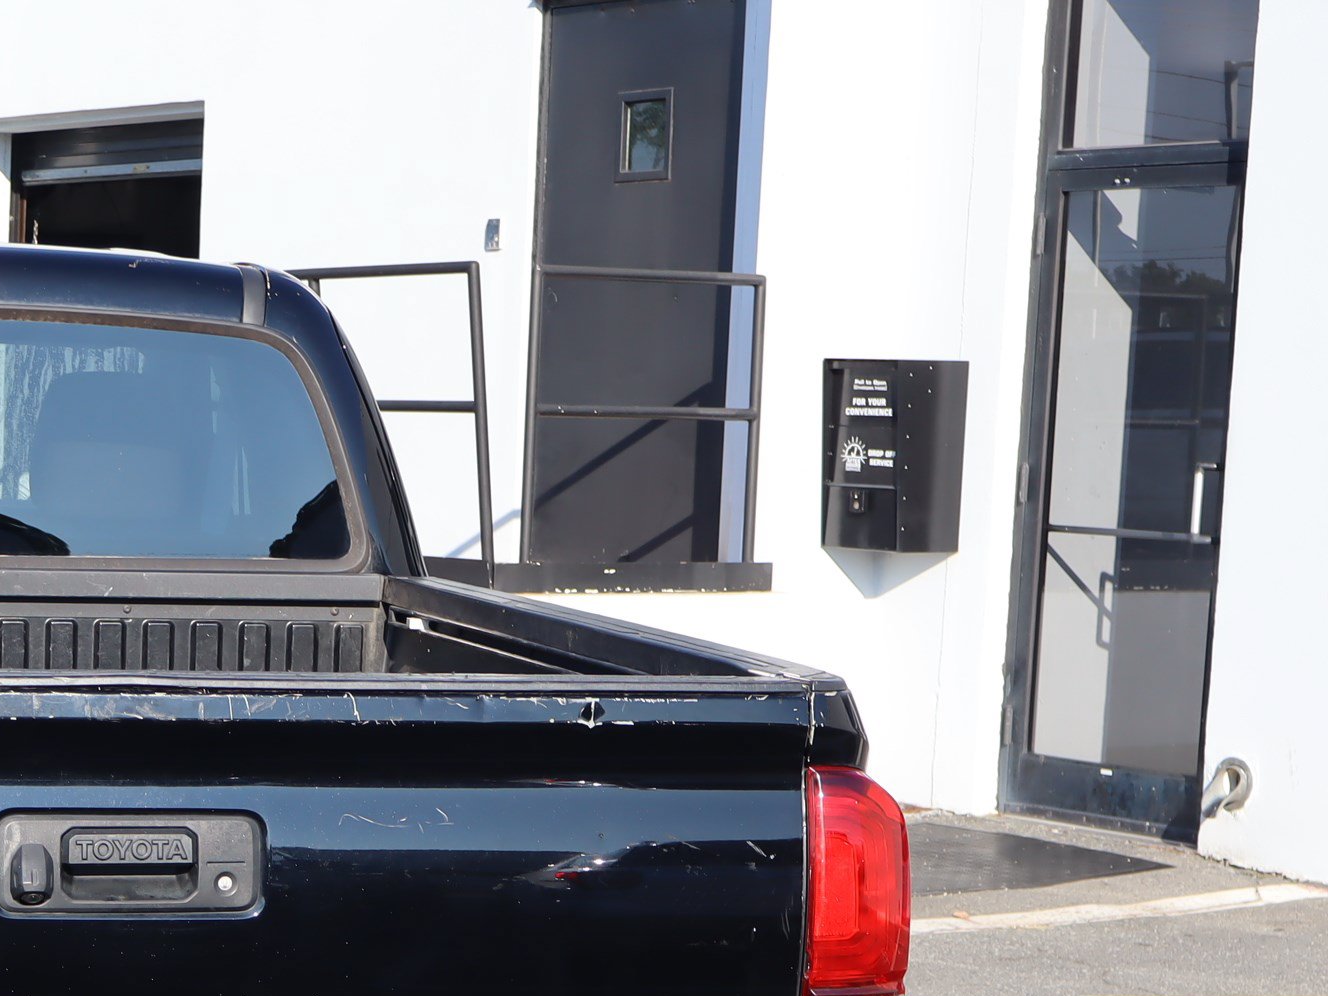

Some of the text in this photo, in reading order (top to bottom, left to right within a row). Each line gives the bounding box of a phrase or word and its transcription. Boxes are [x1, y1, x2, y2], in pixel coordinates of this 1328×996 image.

[852, 397, 887, 407] FOR YOUR
[845, 406, 893, 417] CONVENIENCE
[869, 457, 894, 468] SERVICE
[75, 838, 189, 861] TOYOTA
